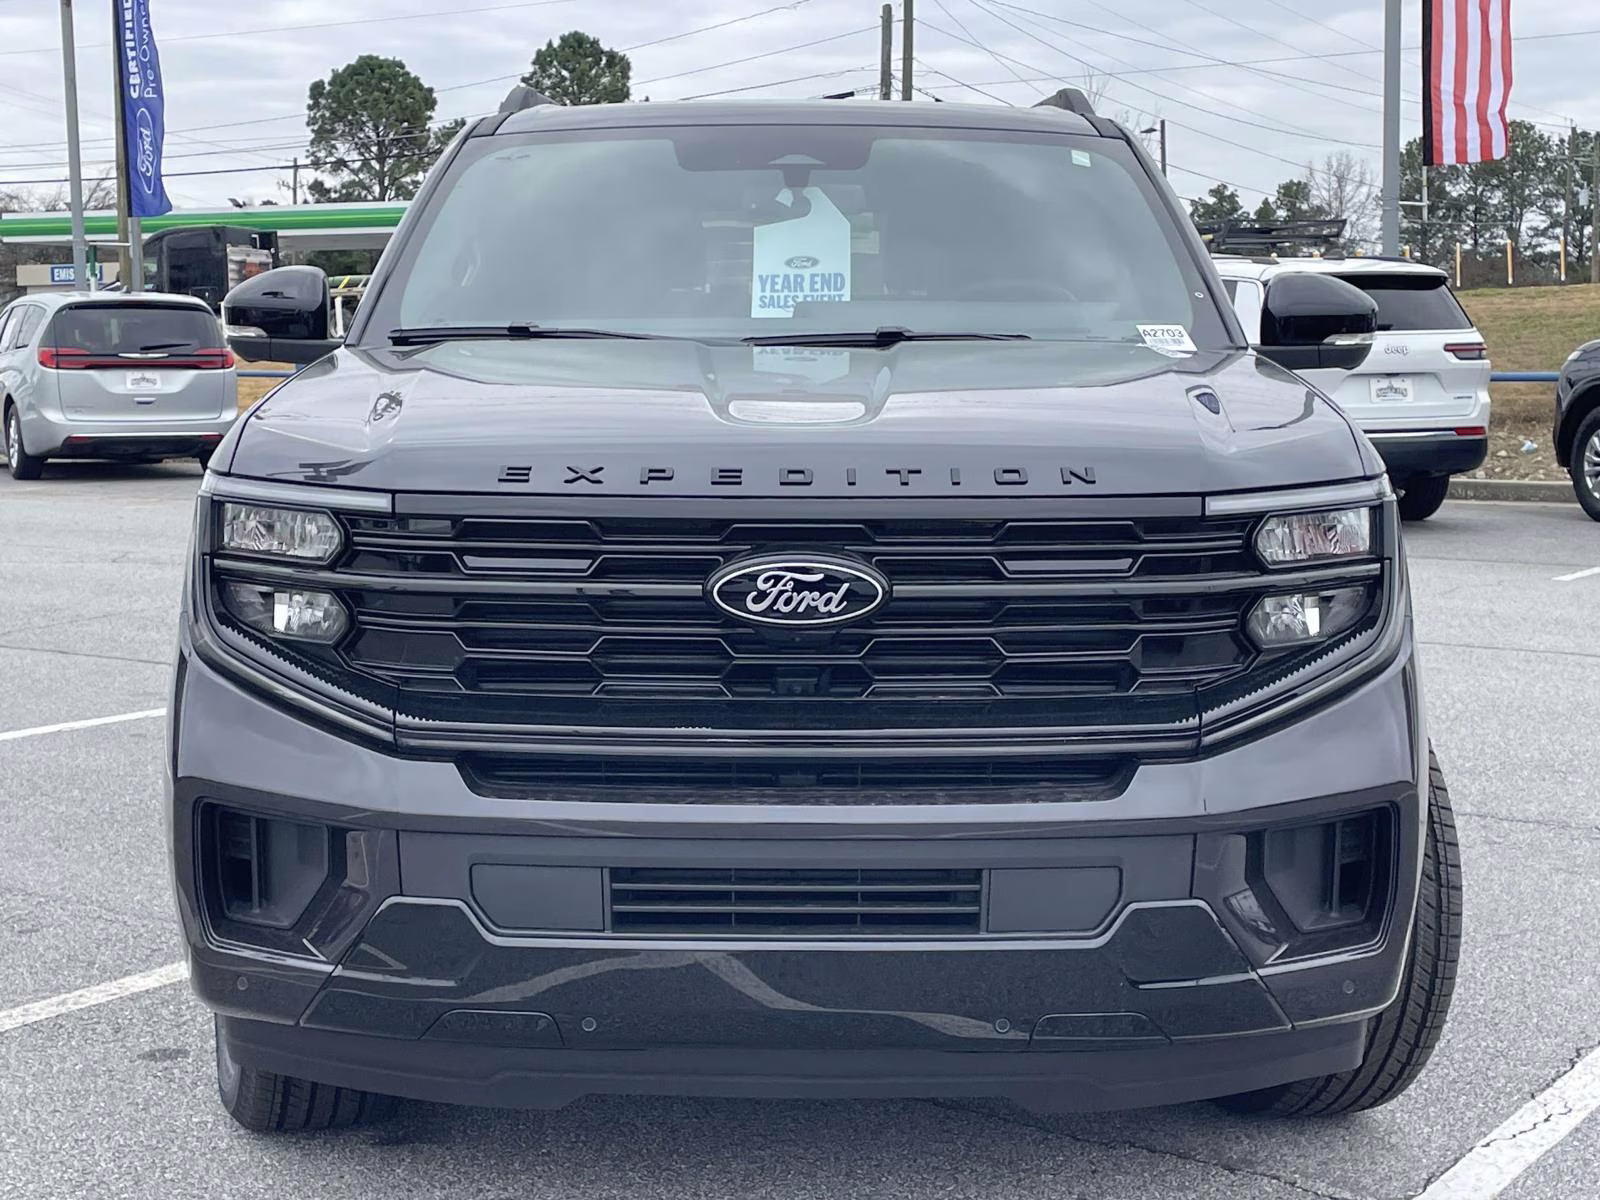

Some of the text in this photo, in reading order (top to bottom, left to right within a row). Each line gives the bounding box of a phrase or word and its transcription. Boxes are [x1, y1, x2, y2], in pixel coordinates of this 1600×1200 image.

[140, 127, 154, 177] Ford
[758, 273, 846, 293] YEAR END
[758, 294, 800, 309] SALES
[1142, 328, 1185, 338] A2703
[498, 465, 1097, 486] EXPEDITION
[745, 570, 850, 613] Ford
